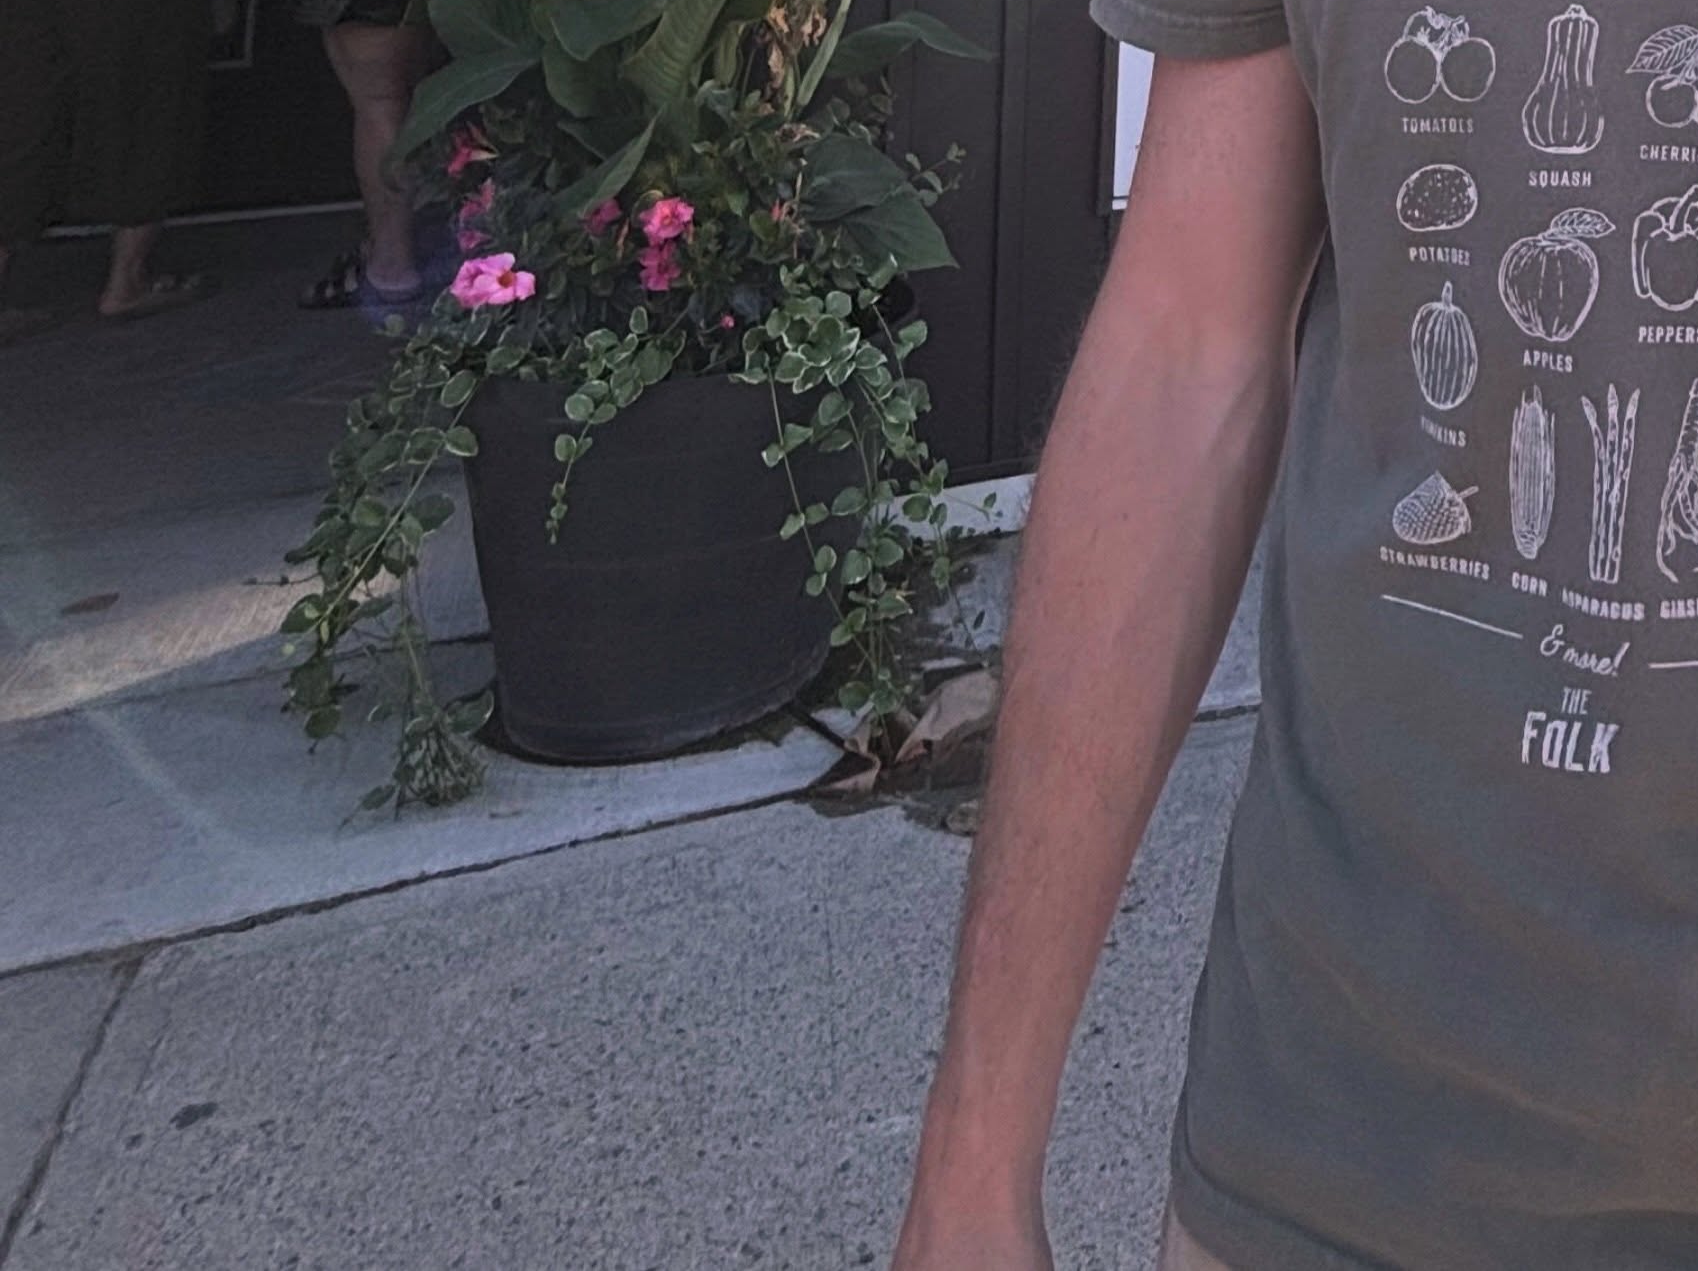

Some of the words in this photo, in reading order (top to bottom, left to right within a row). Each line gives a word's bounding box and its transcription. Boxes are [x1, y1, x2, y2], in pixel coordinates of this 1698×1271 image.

[1402, 117, 1474, 134] TOMATOES
[1528, 170, 1592, 188] SQUASH
[1409, 246, 1470, 266] POTATOES
[1523, 349, 1573, 374] APPLES
[1379, 545, 1491, 580] STRAWBERRIES
[1511, 571, 1548, 597] CORN
[1561, 586, 1646, 621] ASPARAGUS
[1540, 623, 1564, 656] &
[1563, 641, 1631, 677] more!
[1561, 687, 1593, 715] THE
[1521, 710, 1620, 775] FOLK
